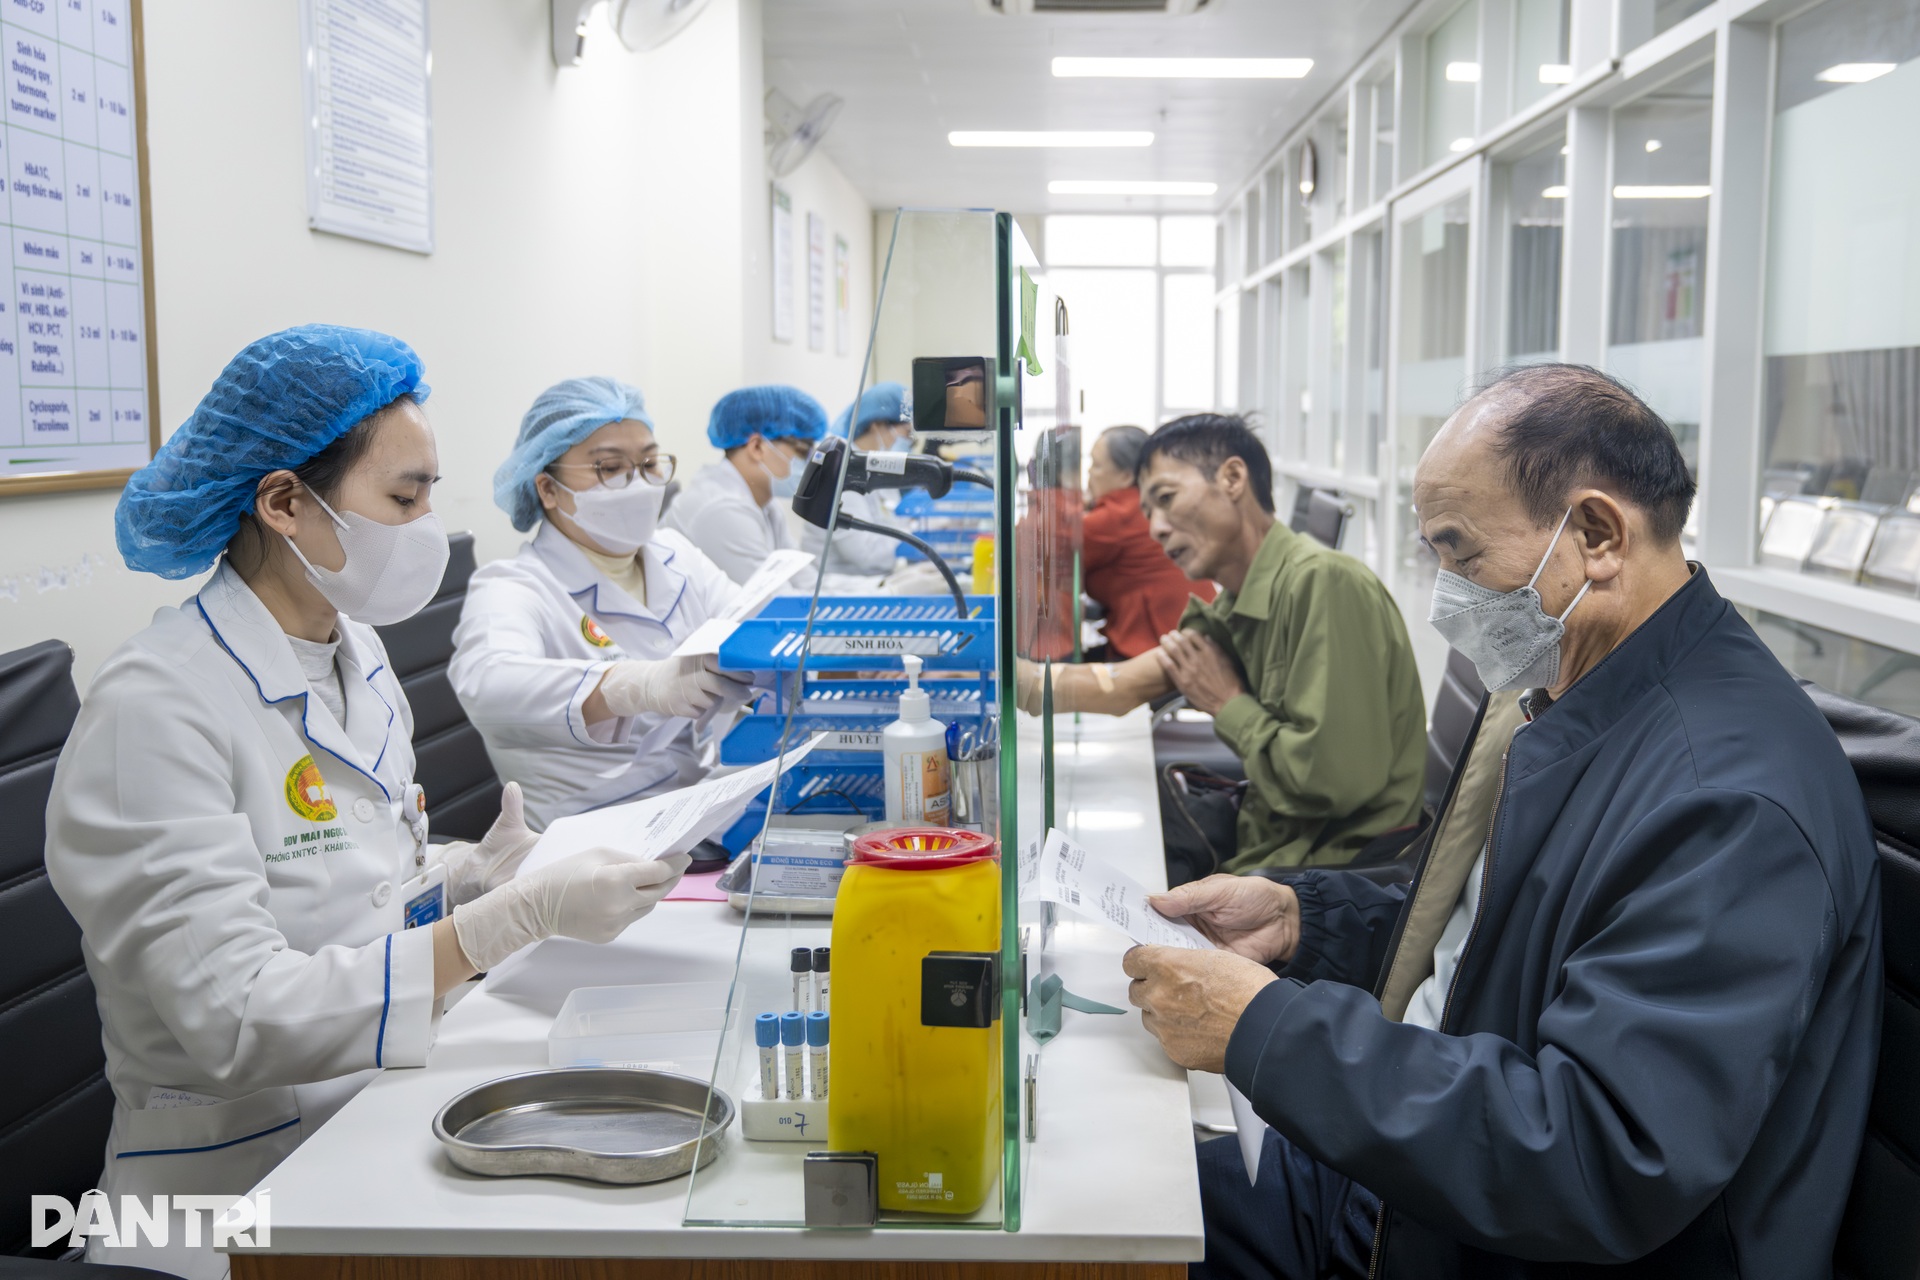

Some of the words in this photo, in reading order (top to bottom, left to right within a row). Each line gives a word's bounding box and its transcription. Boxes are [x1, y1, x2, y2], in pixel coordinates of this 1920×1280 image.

[17, 41, 32, 57] Sinh
[17, 79, 49, 102] hormone,
[11, 98, 31, 114] tumor
[33, 107, 56, 121] marker
[23, 242, 43, 257] Nhóm
[45, 246, 59, 260] máu
[21, 282, 29, 295] Vi
[31, 284, 45, 297] sinh
[19, 302, 34, 317] HIV,
[35, 303, 52, 318] HBS,
[28, 322, 46, 337] HCV,
[47, 323, 63, 339] PCT,
[33, 341, 60, 357] Dengue,
[32, 419, 69, 432] Tacrolimus
[845, 640, 873, 649] SINH
[300, 830, 320, 843] MAI
[323, 827, 342, 840] NGỌC
[292, 846, 318, 859] XNTYC
[779, 1117, 792, 1125] 010
[795, 1112, 809, 1136] 7
